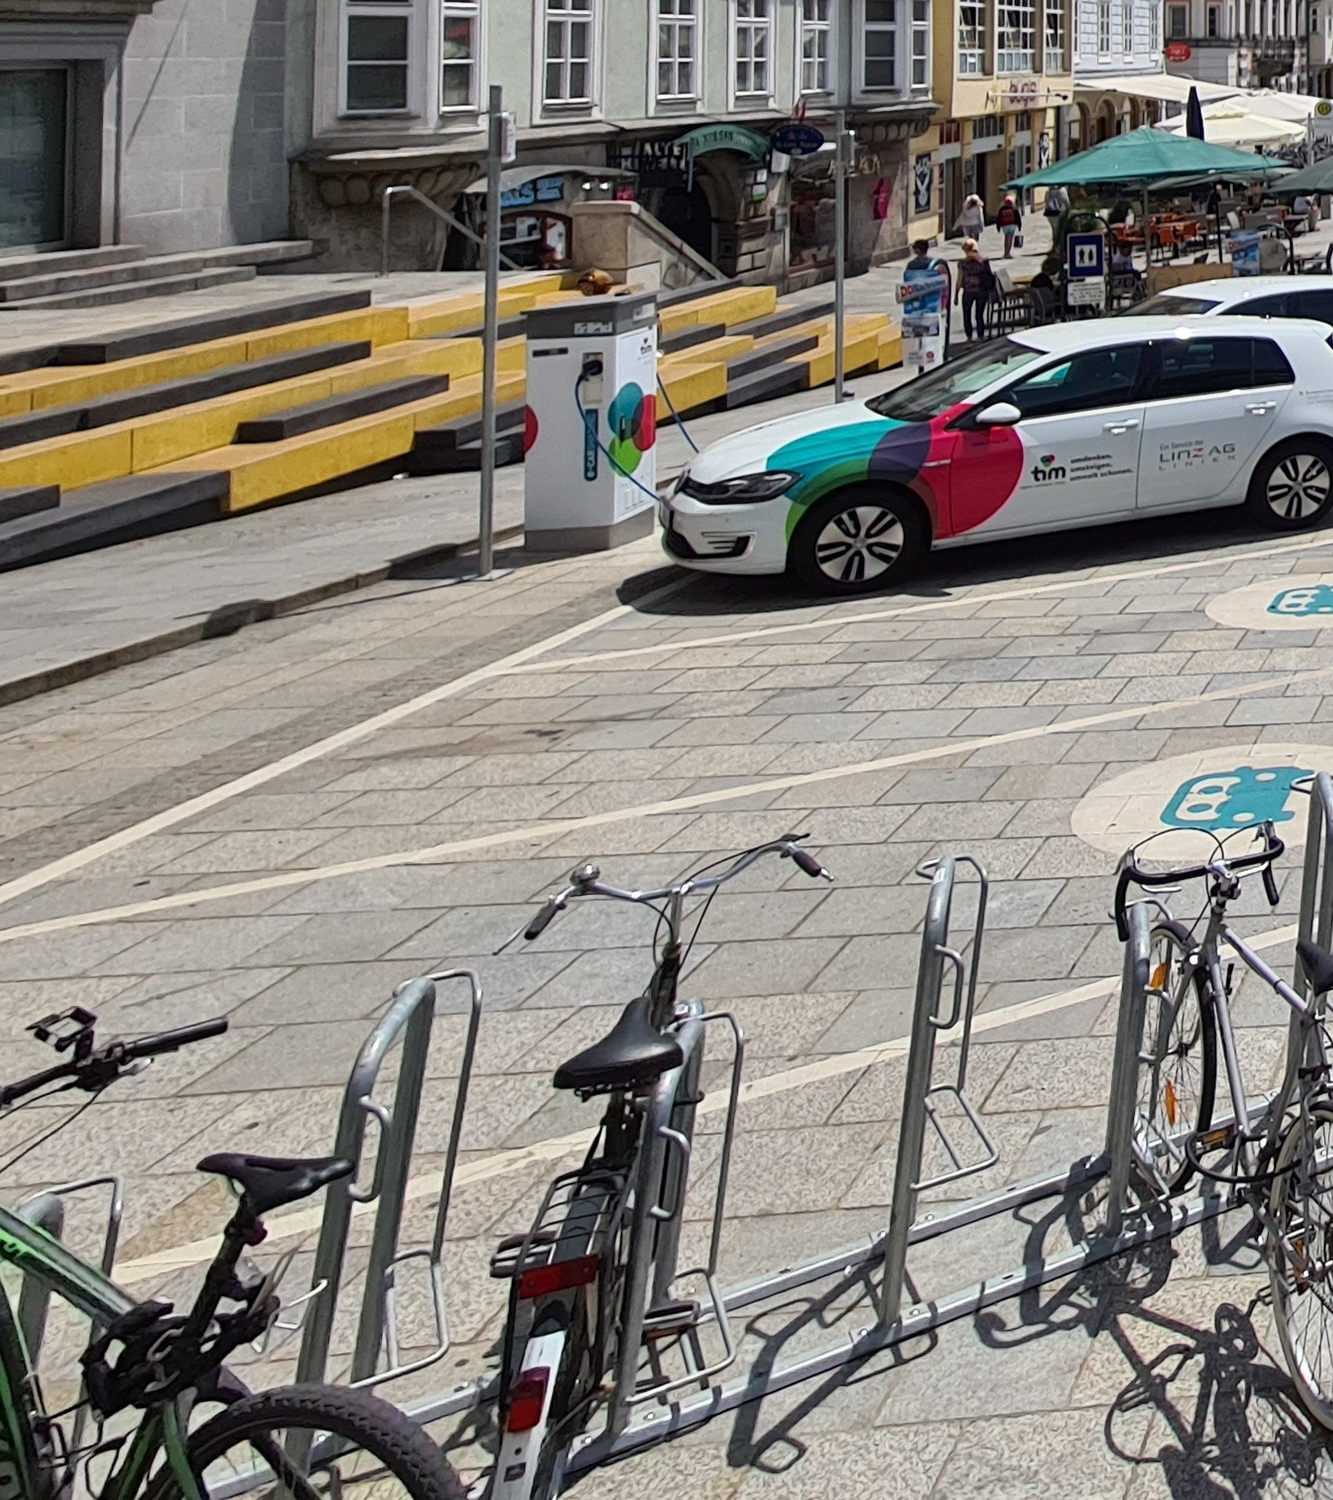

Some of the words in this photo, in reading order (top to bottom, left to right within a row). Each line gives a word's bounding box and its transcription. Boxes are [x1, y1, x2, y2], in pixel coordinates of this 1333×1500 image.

[1159, 447, 1204, 463] LINZ
[1208, 443, 1236, 457] AG
[1158, 454, 1236, 471] LINIEN
